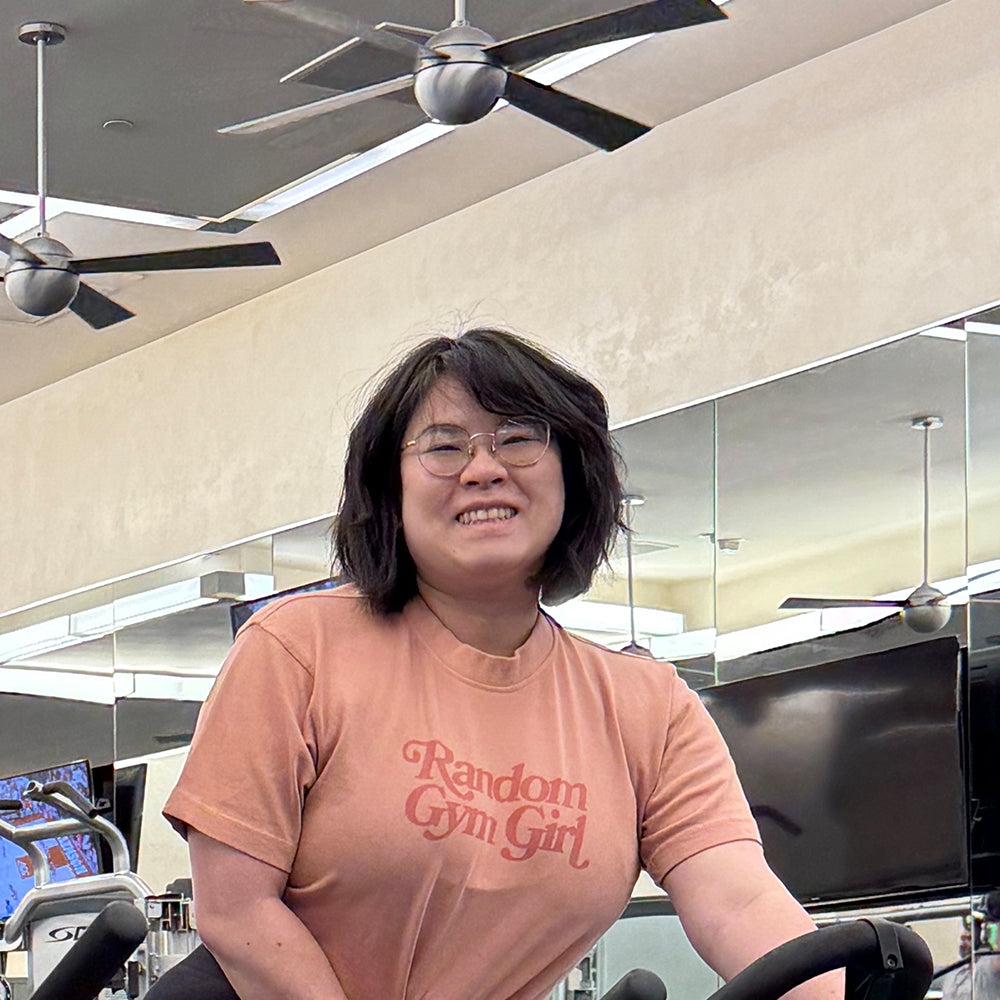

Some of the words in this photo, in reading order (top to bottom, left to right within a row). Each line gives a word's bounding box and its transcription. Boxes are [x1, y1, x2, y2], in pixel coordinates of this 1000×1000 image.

[402, 739, 588, 812] Random
[405, 783, 498, 845] Gym
[500, 804, 590, 870] Girl
